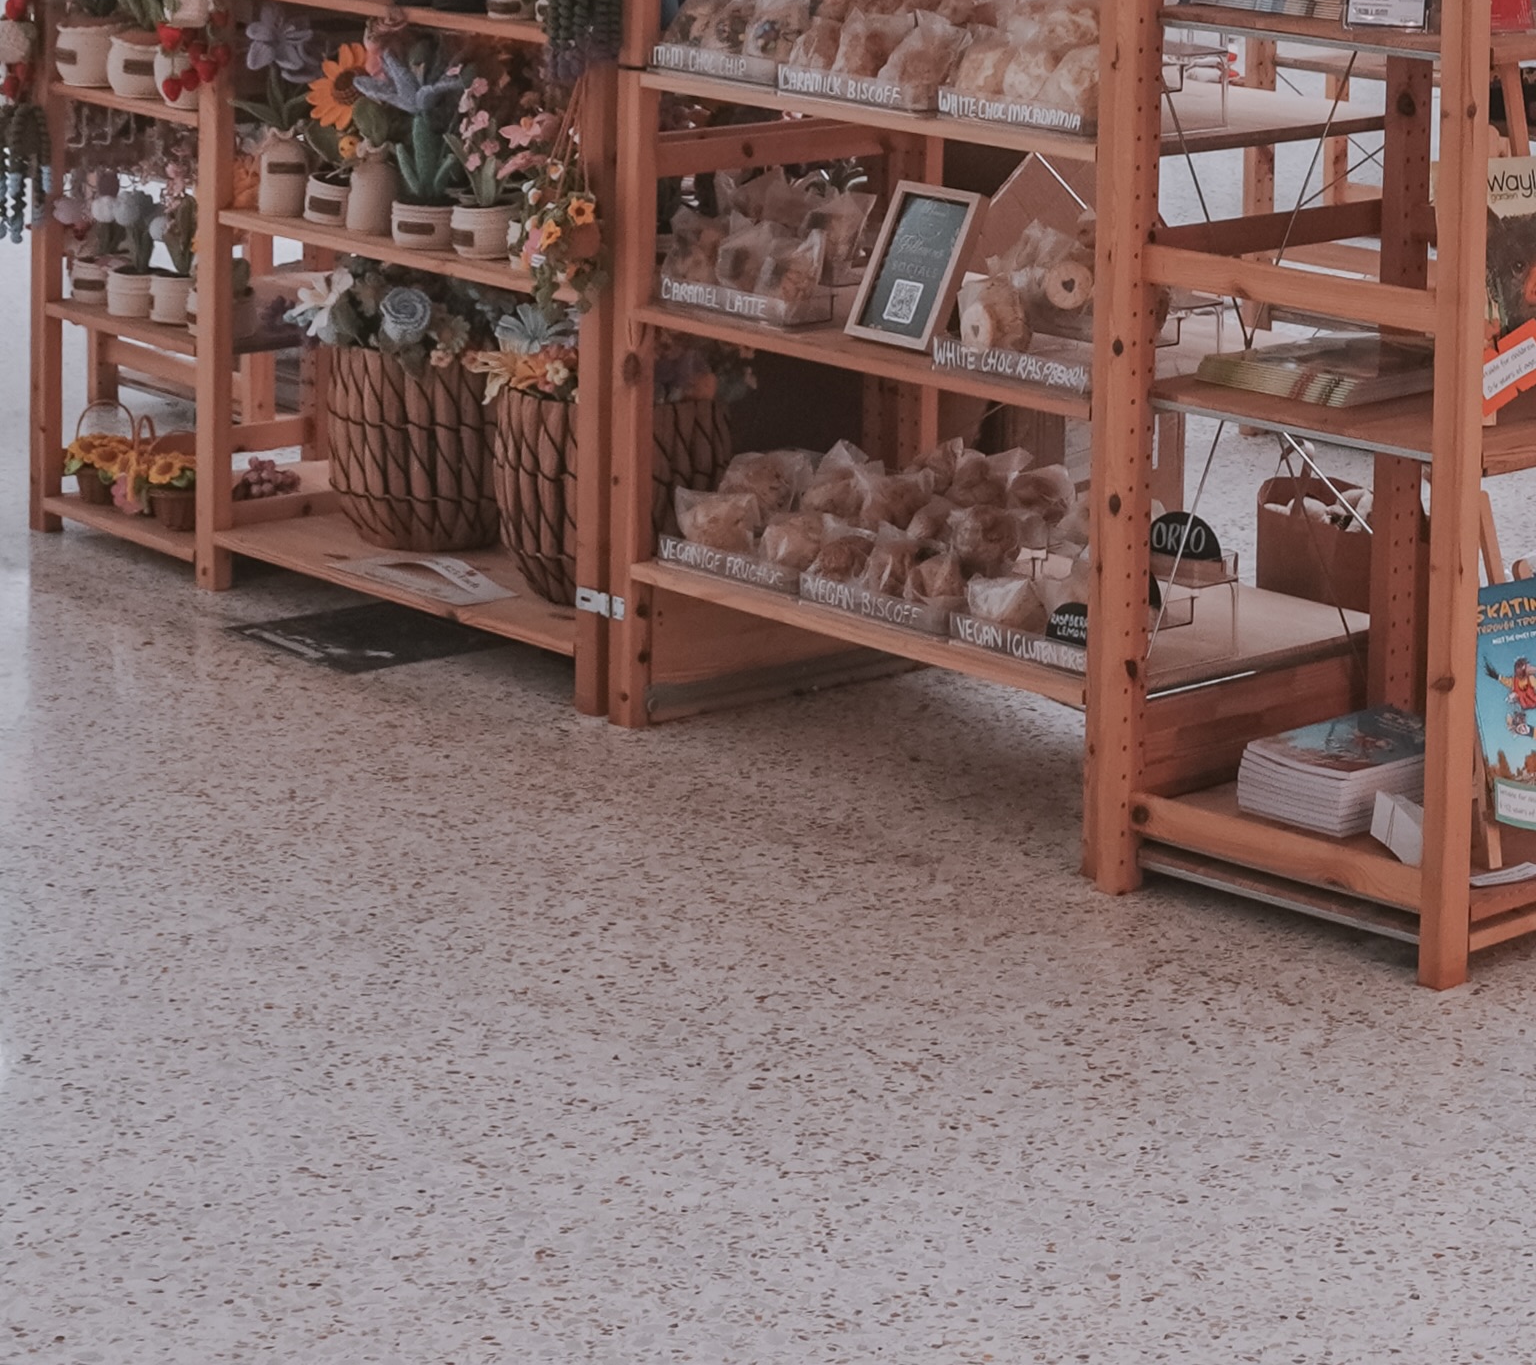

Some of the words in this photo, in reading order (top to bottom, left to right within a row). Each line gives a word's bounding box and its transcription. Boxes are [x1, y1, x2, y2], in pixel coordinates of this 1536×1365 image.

[780, 68, 841, 96] CARAMILK
[847, 80, 901, 105] BISCOFF
[938, 90, 977, 117] WHITE
[978, 99, 1006, 118] CHOC
[1007, 103, 1081, 131] MACADAMIA
[661, 277, 720, 310] CARAMEL
[725, 286, 767, 317] LATTE
[933, 336, 979, 370] WHITE
[981, 349, 1013, 374] CHOC
[1015, 355, 1088, 394] RASPBERRY
[806, 576, 854, 610] VEGAN
[861, 592, 923, 625] BISCOFF
[956, 616, 1002, 649] VEGAN
